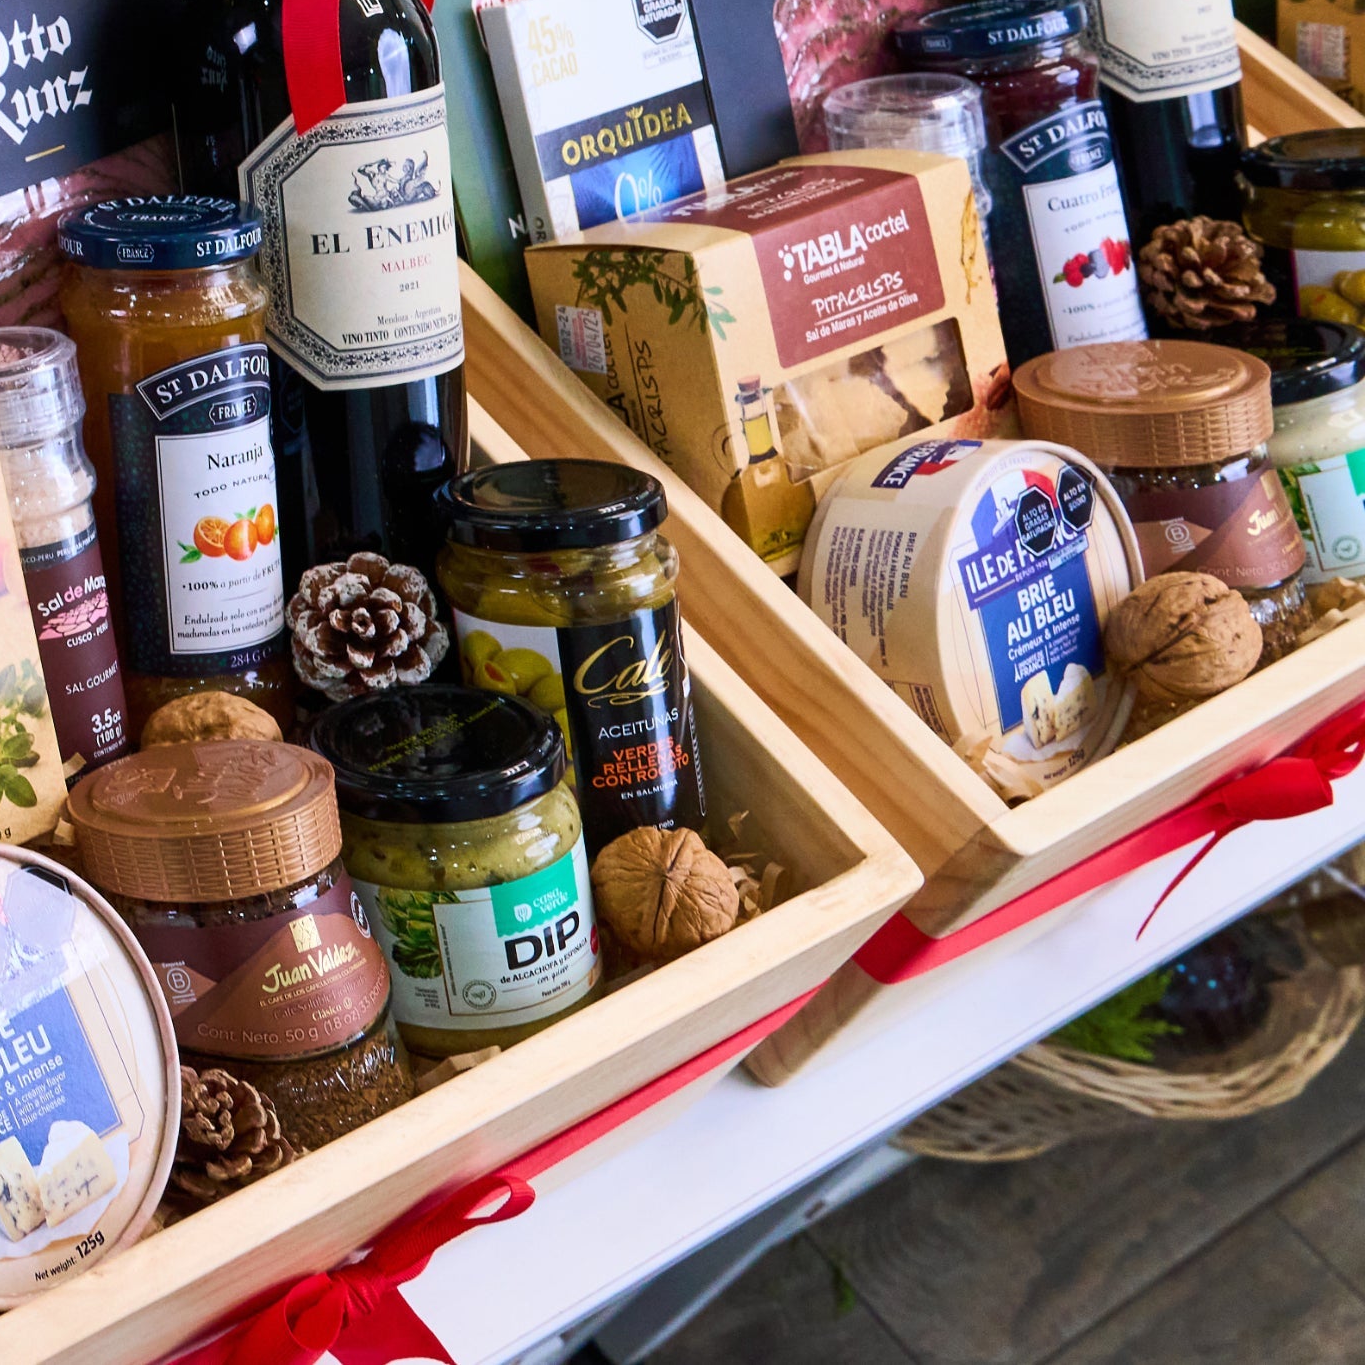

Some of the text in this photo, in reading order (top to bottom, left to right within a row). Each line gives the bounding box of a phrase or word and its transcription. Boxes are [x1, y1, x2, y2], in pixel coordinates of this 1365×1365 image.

[312, 233, 350, 256] EL
[791, 210, 910, 271] TABLA coctel
[381, 254, 432, 274] MALBEC
[812, 271, 905, 317] PITACRISPS
[219, 400, 254, 421] FRANCE
[207, 443, 264, 472] Naranja
[965, 551, 1018, 594] ILE DE
[1018, 578, 1056, 612] BRIE
[1006, 587, 1076, 646] AU BLEU
[598, 708, 678, 740] ACEITUNAS
[602, 744, 683, 777] RELLENAS
[612, 736, 675, 762] VERDES
[592, 754, 689, 789] CON ROCOTO
[533, 888, 561, 910] casa
[540, 891, 569, 914] verde
[504, 911, 580, 971] DIP
[262, 942, 359, 995] Juan Valdez
[76, 1231, 105, 1261] 125g
